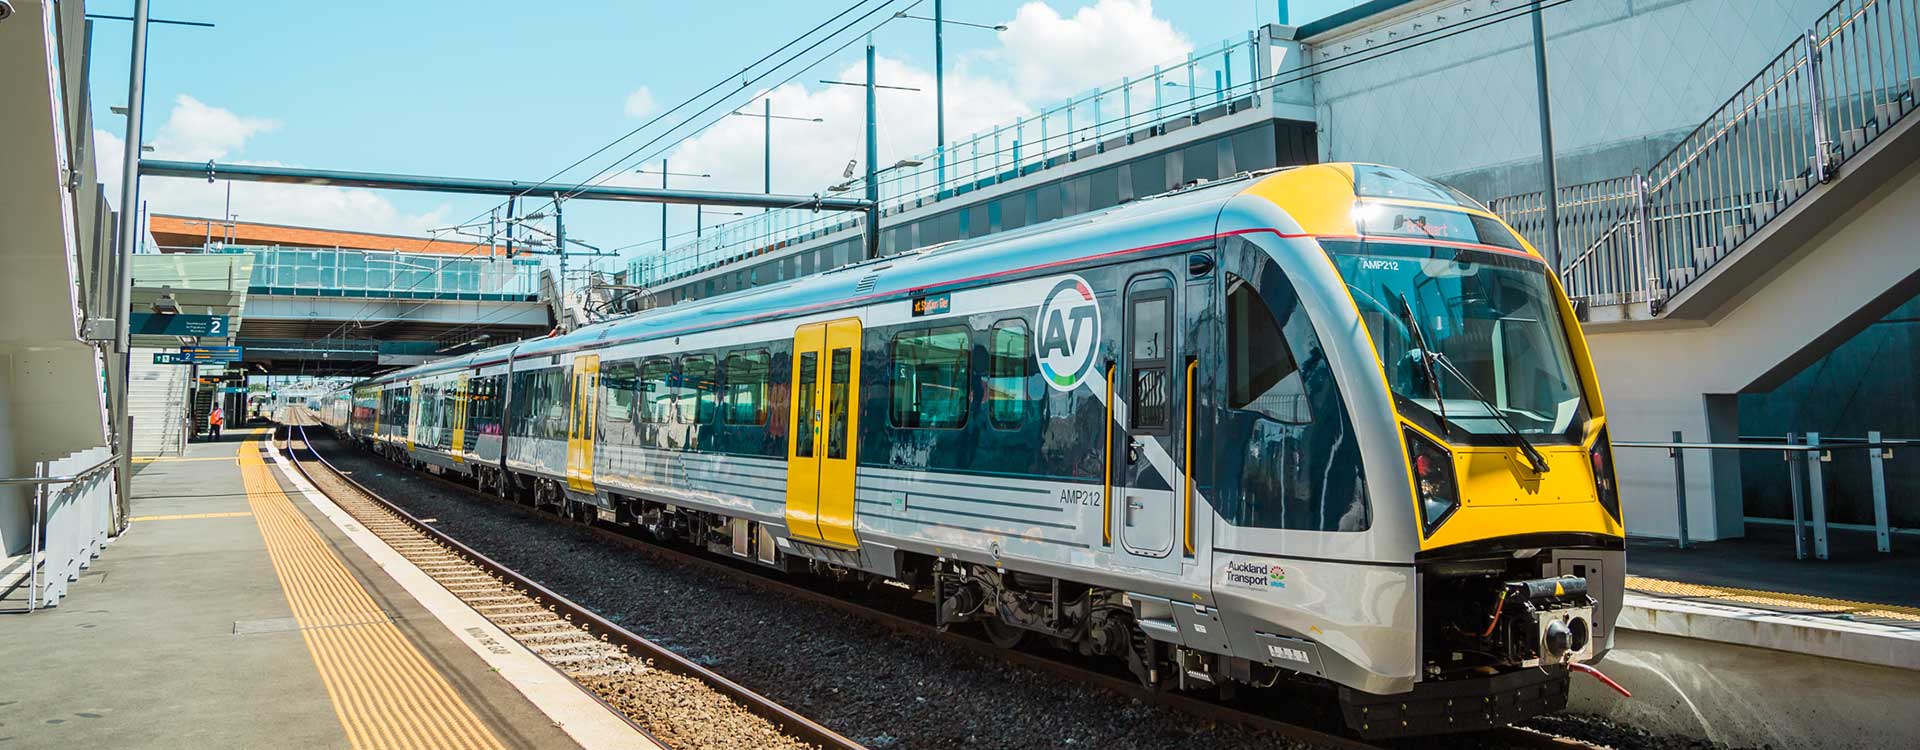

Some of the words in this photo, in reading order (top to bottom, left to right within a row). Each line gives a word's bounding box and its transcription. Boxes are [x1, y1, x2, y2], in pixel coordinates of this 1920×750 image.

[1363, 260, 1399, 271] AMP212
[210, 321, 221, 333] 2
[1040, 306, 1096, 358] AT
[1060, 489, 1101, 506] AMP212
[1228, 560, 1268, 575] Auckland
[1226, 570, 1268, 586] Transport
